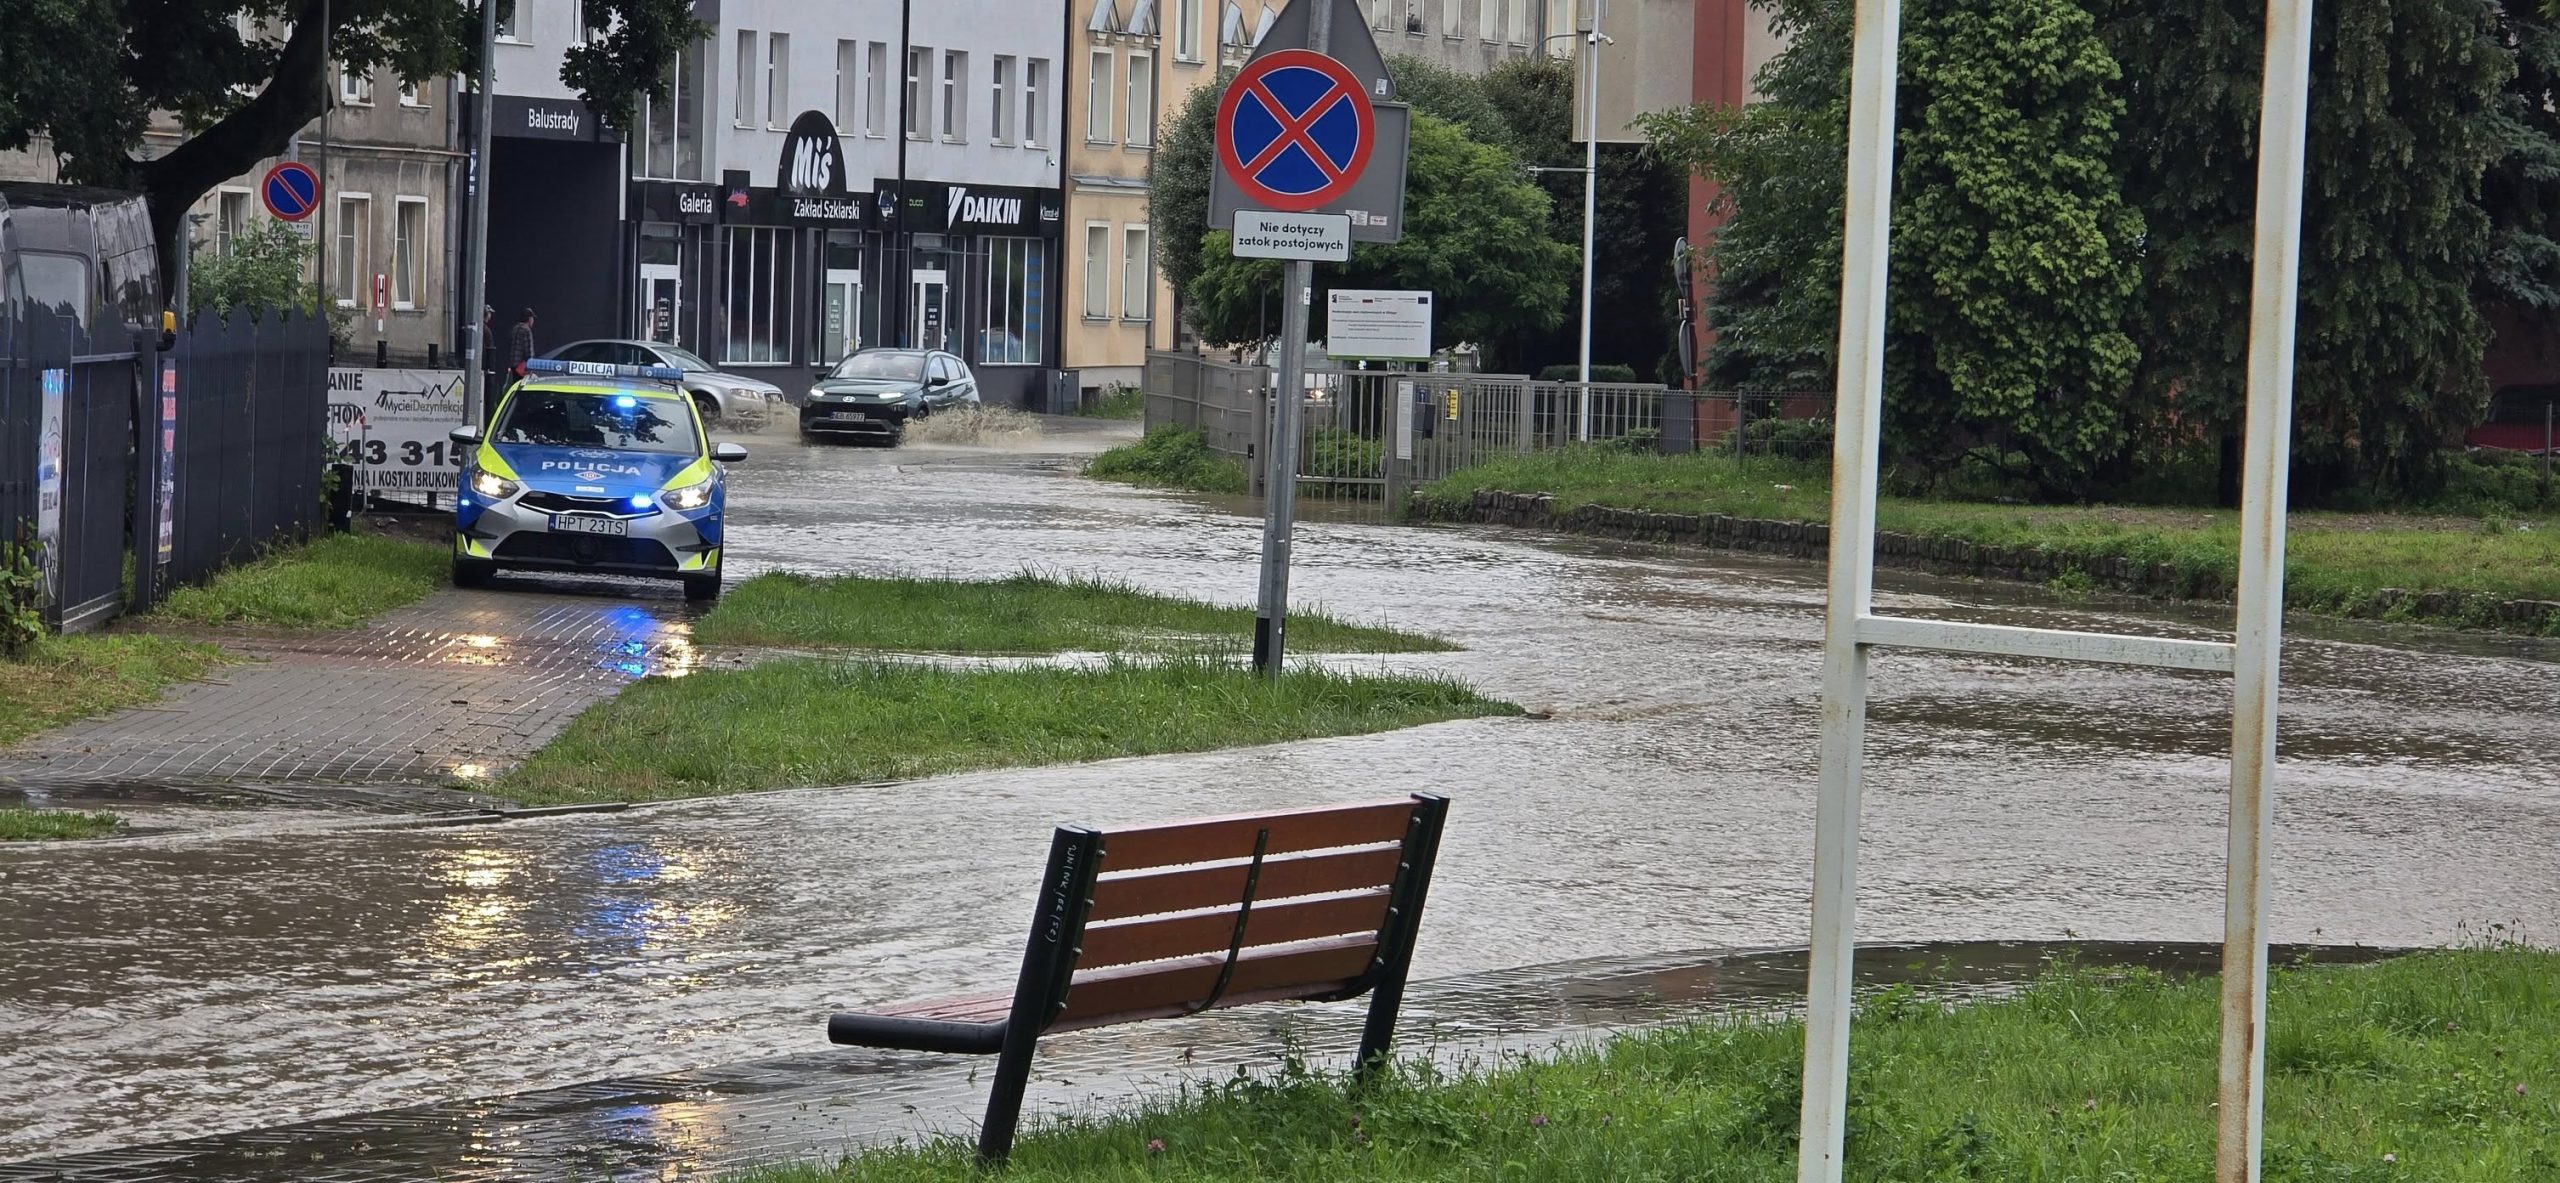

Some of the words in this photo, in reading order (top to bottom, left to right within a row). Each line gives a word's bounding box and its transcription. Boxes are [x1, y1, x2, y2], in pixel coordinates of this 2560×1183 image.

[528, 107, 580, 137] Balustrady
[791, 136, 832, 190] Miś
[679, 192, 712, 214] Galeria
[794, 198, 822, 218] Zakład
[823, 199, 860, 220] Szklarski
[962, 196, 1021, 225] DAIKIN
[1259, 221, 1279, 234] Nie
[1282, 223, 1325, 237] dotyczy
[1238, 236, 1271, 247] zatok
[1273, 238, 1344, 252] postojowych
[570, 361, 614, 376] POLICJA
[542, 460, 642, 477] POLICJA
[378, 470, 413, 488] KOSTKI
[558, 516, 585, 530] HPT
[589, 519, 623, 534] 23TS
